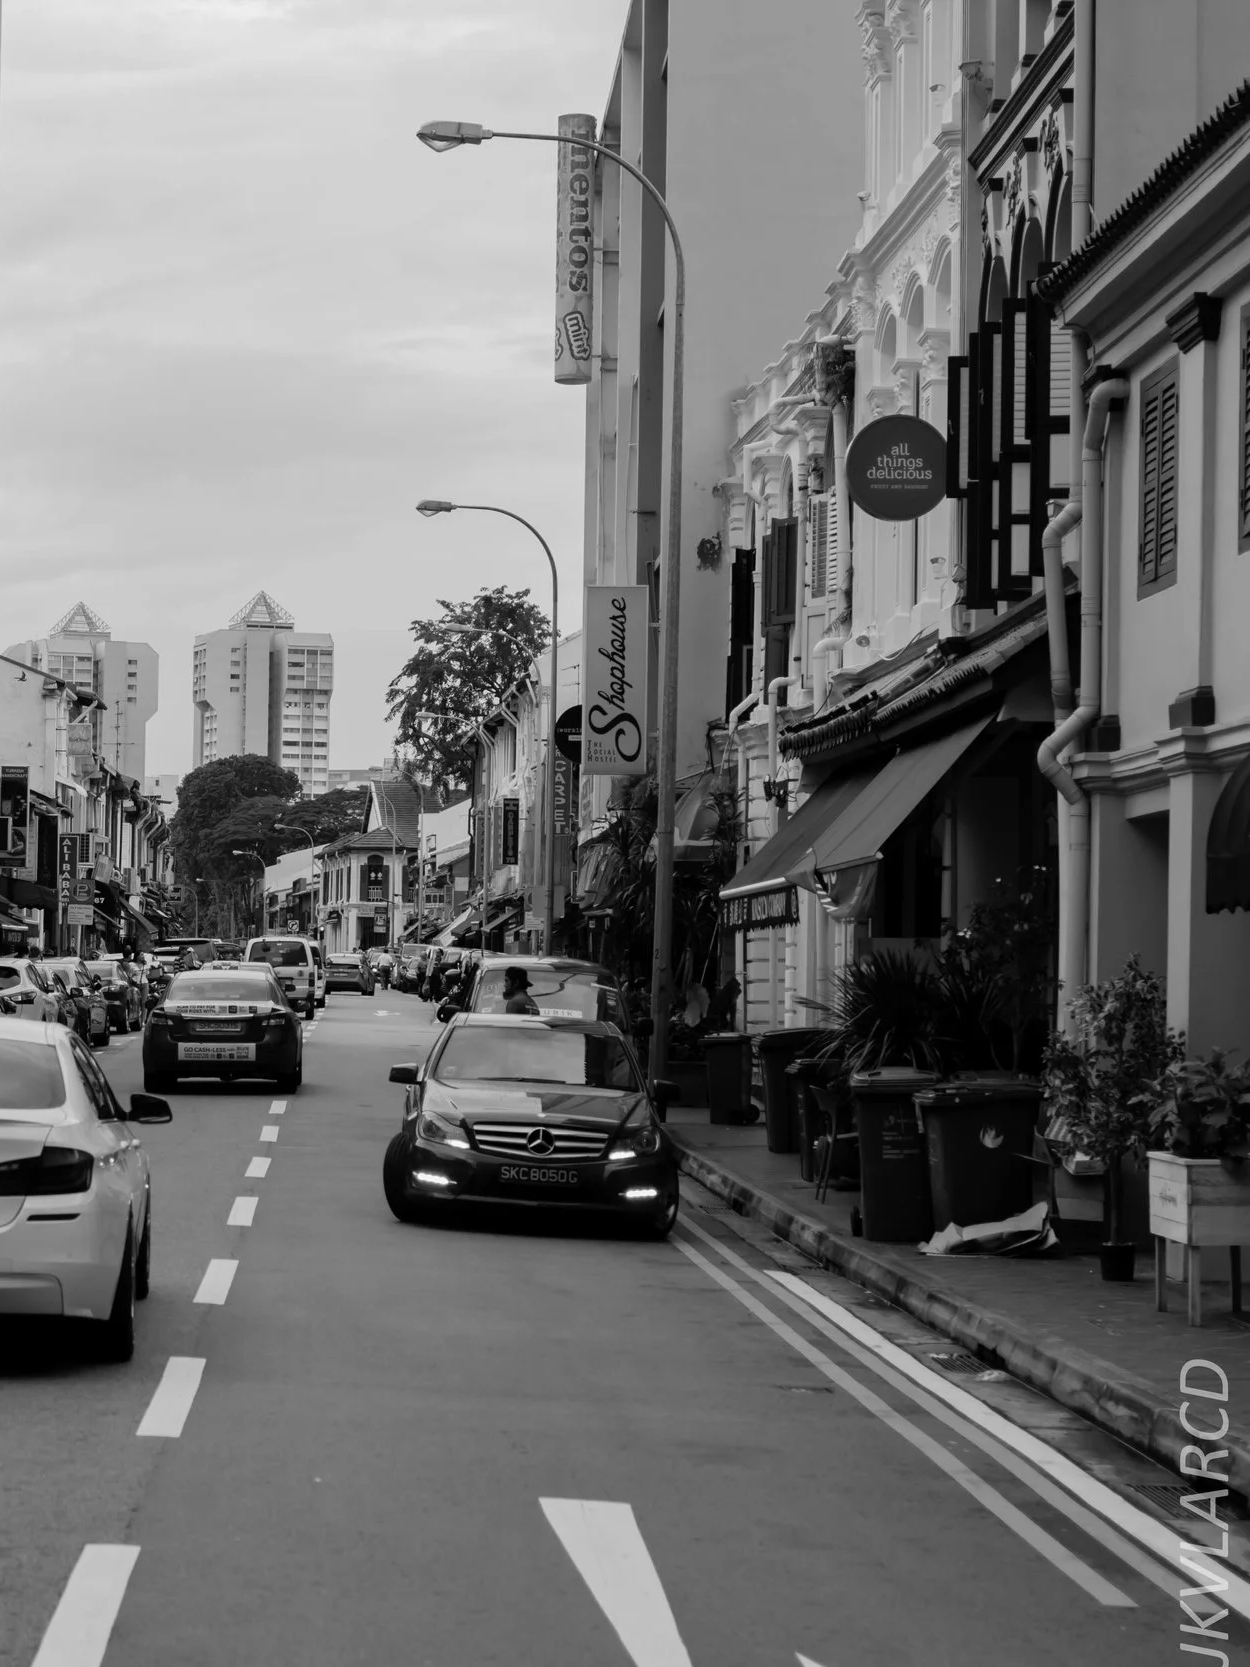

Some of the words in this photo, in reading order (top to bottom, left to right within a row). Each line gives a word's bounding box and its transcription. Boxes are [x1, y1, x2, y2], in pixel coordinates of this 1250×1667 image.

[569, 129, 592, 292] mentos
[566, 314, 590, 358] mint
[891, 443, 910, 456] all
[877, 454, 923, 470] things
[867, 466, 933, 479] delicious
[588, 596, 642, 763] Shophouse
[587, 740, 602, 748] THE
[587, 755, 617, 763] HOSTEL
